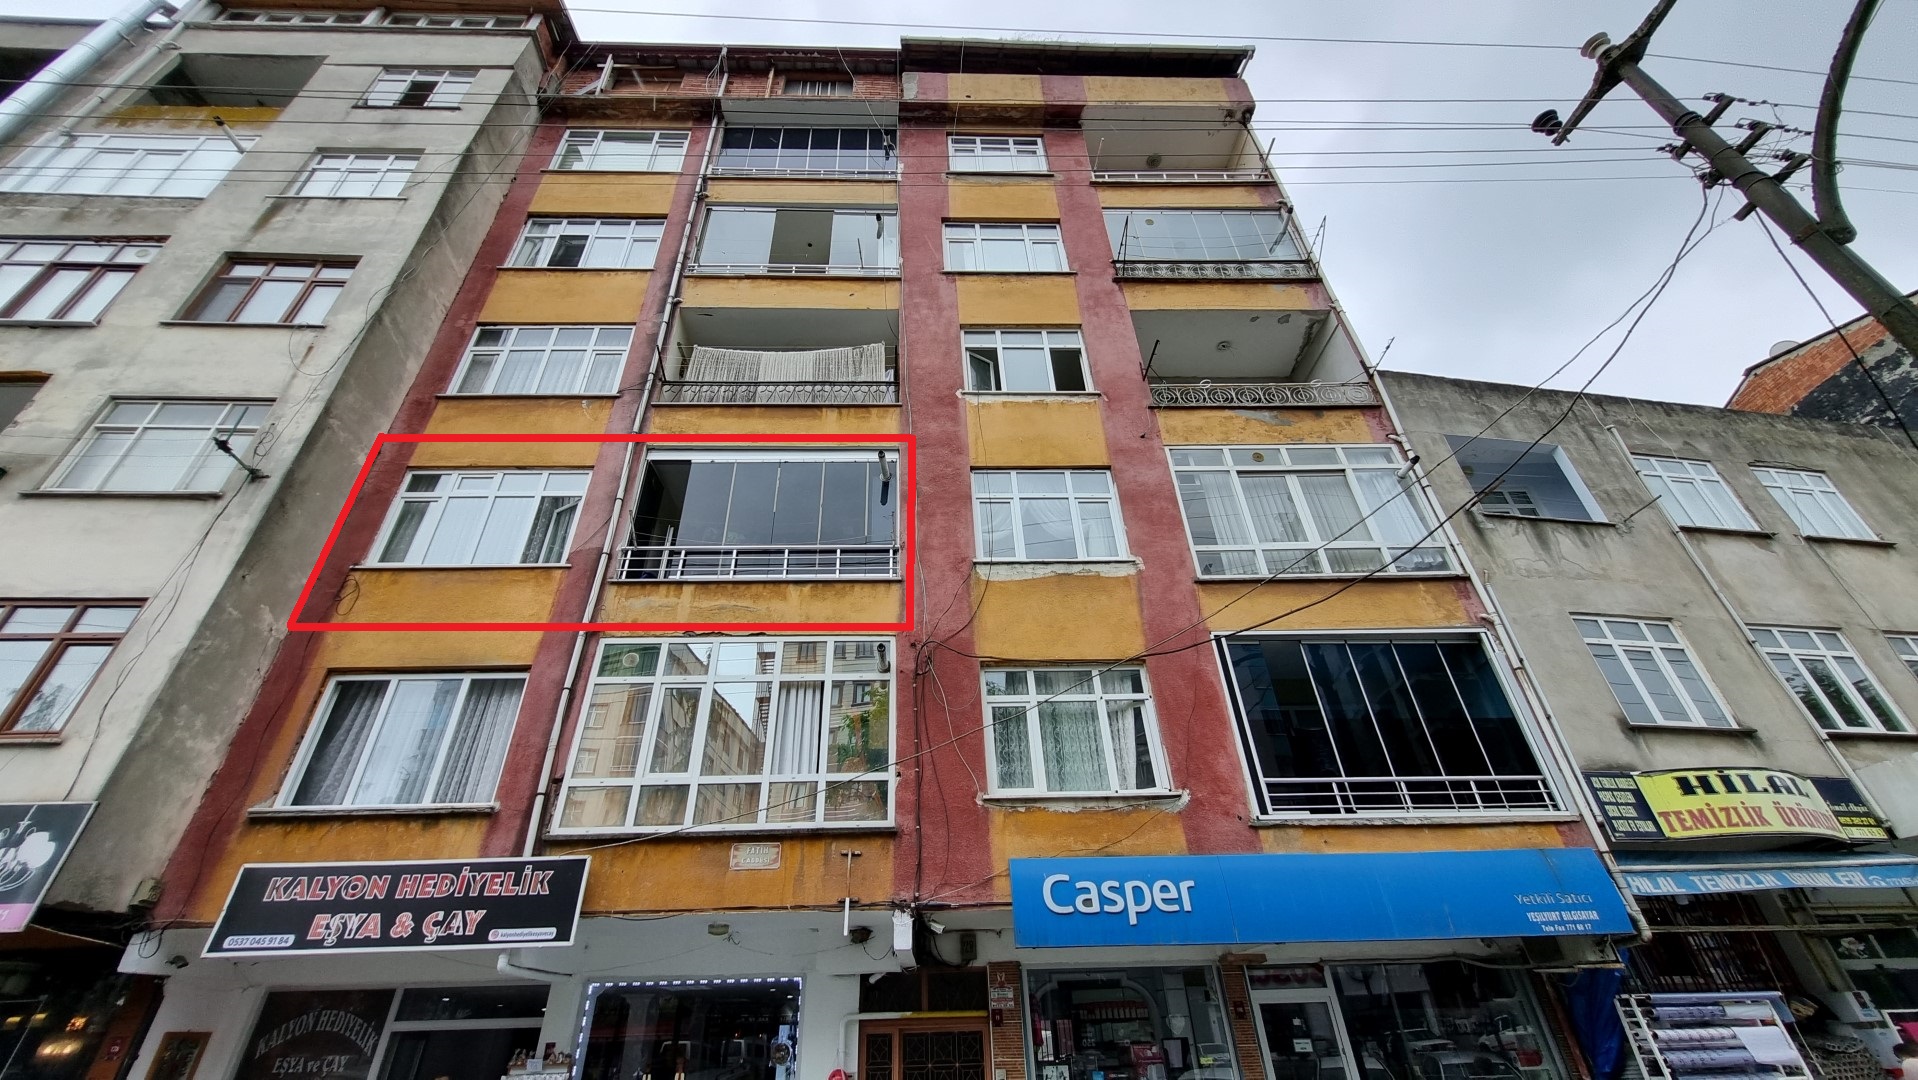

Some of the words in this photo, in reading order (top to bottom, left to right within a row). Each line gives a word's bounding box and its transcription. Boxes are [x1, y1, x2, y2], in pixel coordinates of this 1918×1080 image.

[1672, 770, 1812, 798] HİLAL
[1656, 802, 1773, 833] TEMİZLİK
[263, 875, 391, 902] KALYON
[395, 865, 555, 899] HEDİYELİK
[1513, 893, 1556, 905] Yetkili
[1555, 892, 1594, 904] Satıcı
[1042, 873, 1196, 926] Casper
[228, 937, 250, 947] 0537
[249, 937, 268, 946] 045
[267, 936, 278, 945] 91
[278, 936, 290, 945] 84
[307, 913, 382, 947] EŞYA
[390, 912, 415, 939] &
[422, 910, 488, 944] ÇAY
[254, 1011, 319, 1060] KALYON
[272, 1056, 304, 1079] EŞYA
[306, 1059, 320, 1073] ve
[321, 1055, 351, 1078] ÇAY
